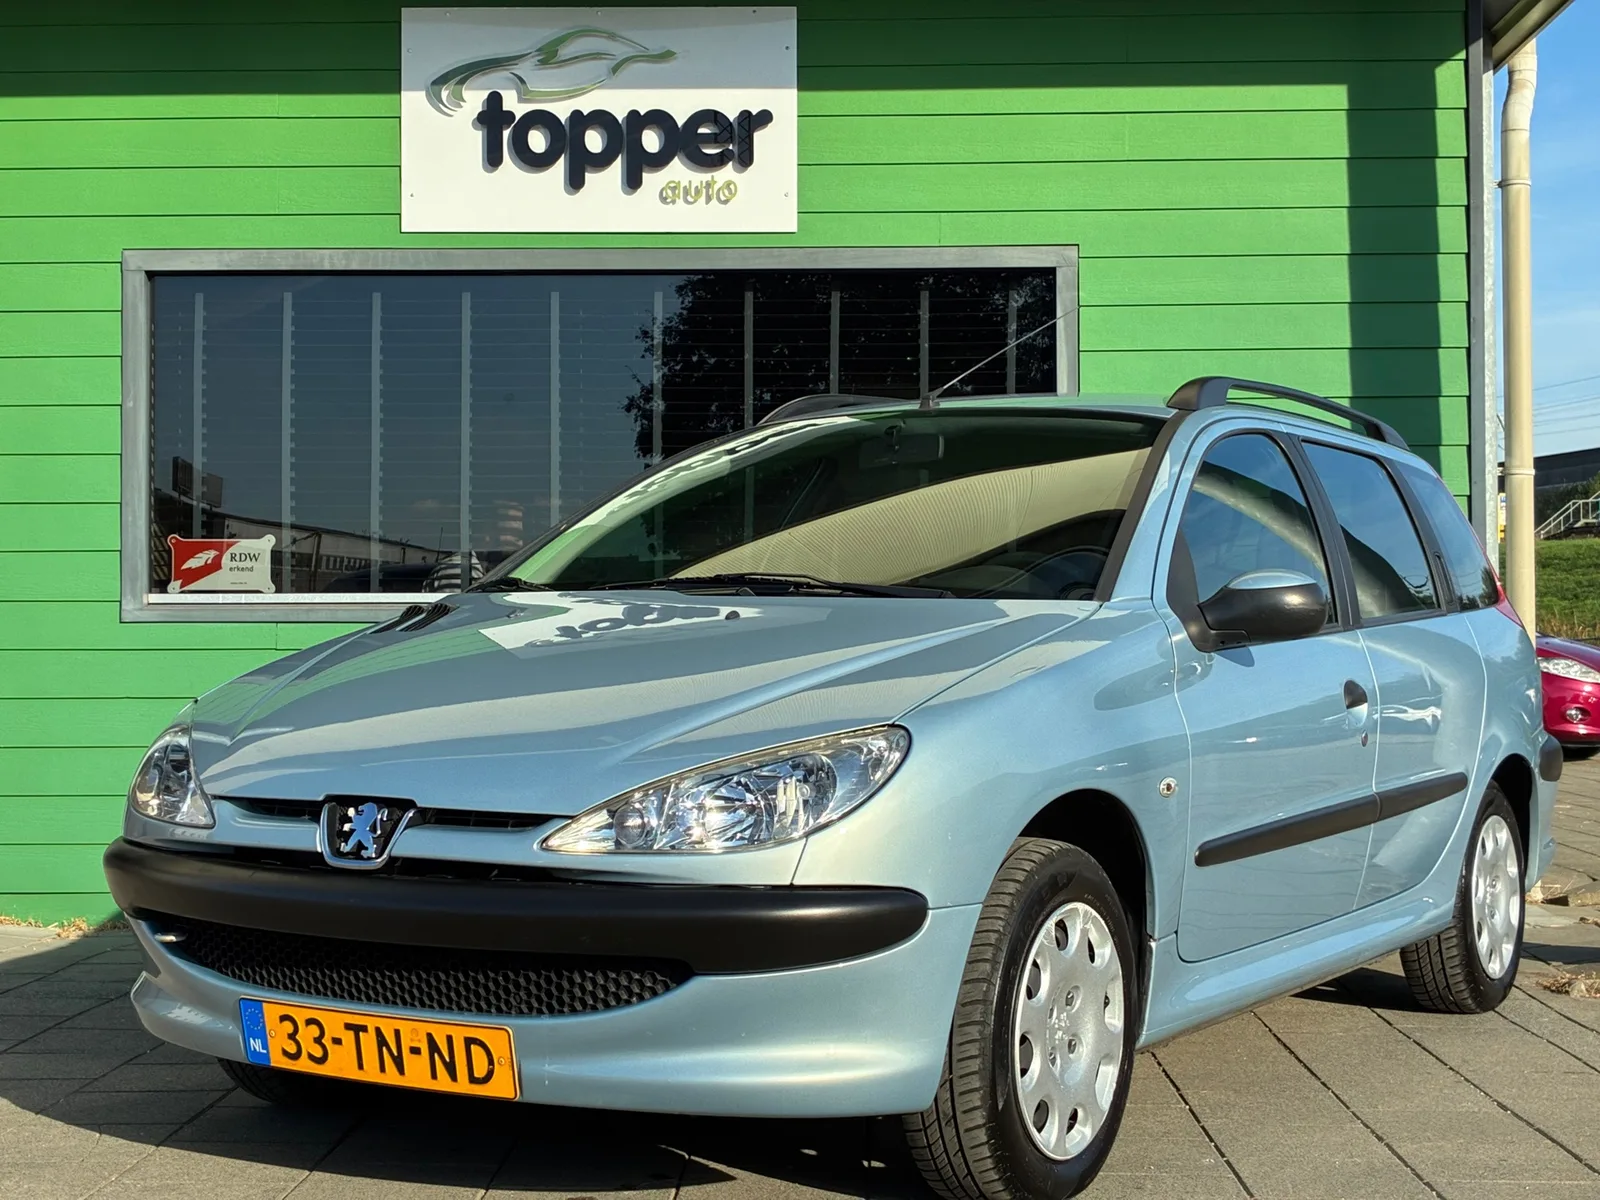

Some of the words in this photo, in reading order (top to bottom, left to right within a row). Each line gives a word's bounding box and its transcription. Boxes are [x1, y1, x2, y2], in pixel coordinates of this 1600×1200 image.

[476, 90, 774, 191] topper
[663, 175, 738, 203] auto
[229, 552, 261, 562] RDW
[228, 565, 254, 573] erkend
[249, 1037, 267, 1054] NL
[278, 1013, 495, 1085] 33-TN-ND
